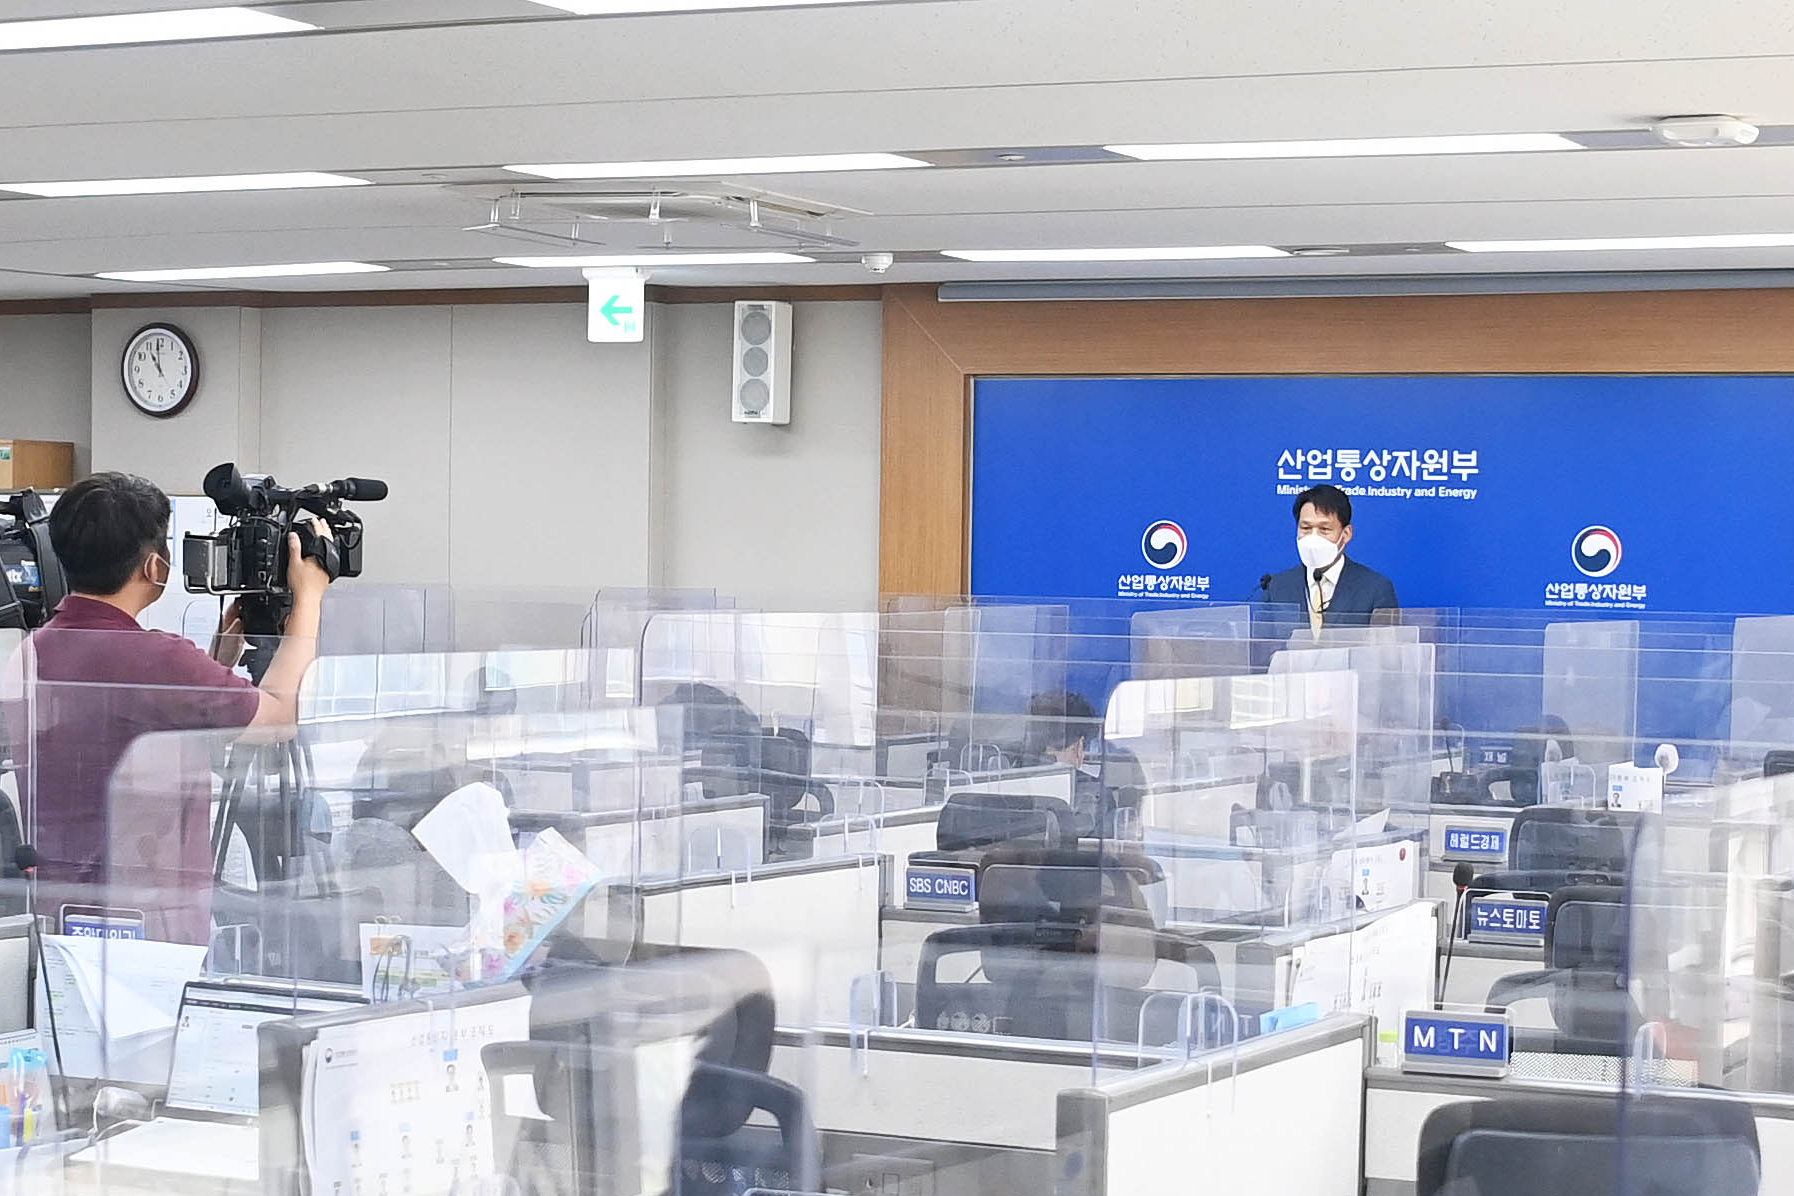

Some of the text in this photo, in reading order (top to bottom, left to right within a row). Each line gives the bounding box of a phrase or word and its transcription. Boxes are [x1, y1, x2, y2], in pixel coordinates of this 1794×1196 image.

[1277, 449, 1479, 481] 산업통상자원부
[1414, 486, 1436, 497] and
[1438, 486, 1478, 500] Energy
[1118, 574, 1210, 591] 산업통상자원부
[1545, 582, 1647, 600] 산업통상자원부
[1449, 832, 1500, 850] 헤럴드경제
[909, 877, 969, 896] SBS CNBC
[1476, 906, 1542, 930] 뉴스토마토
[1413, 1025, 1497, 1053] MTN
